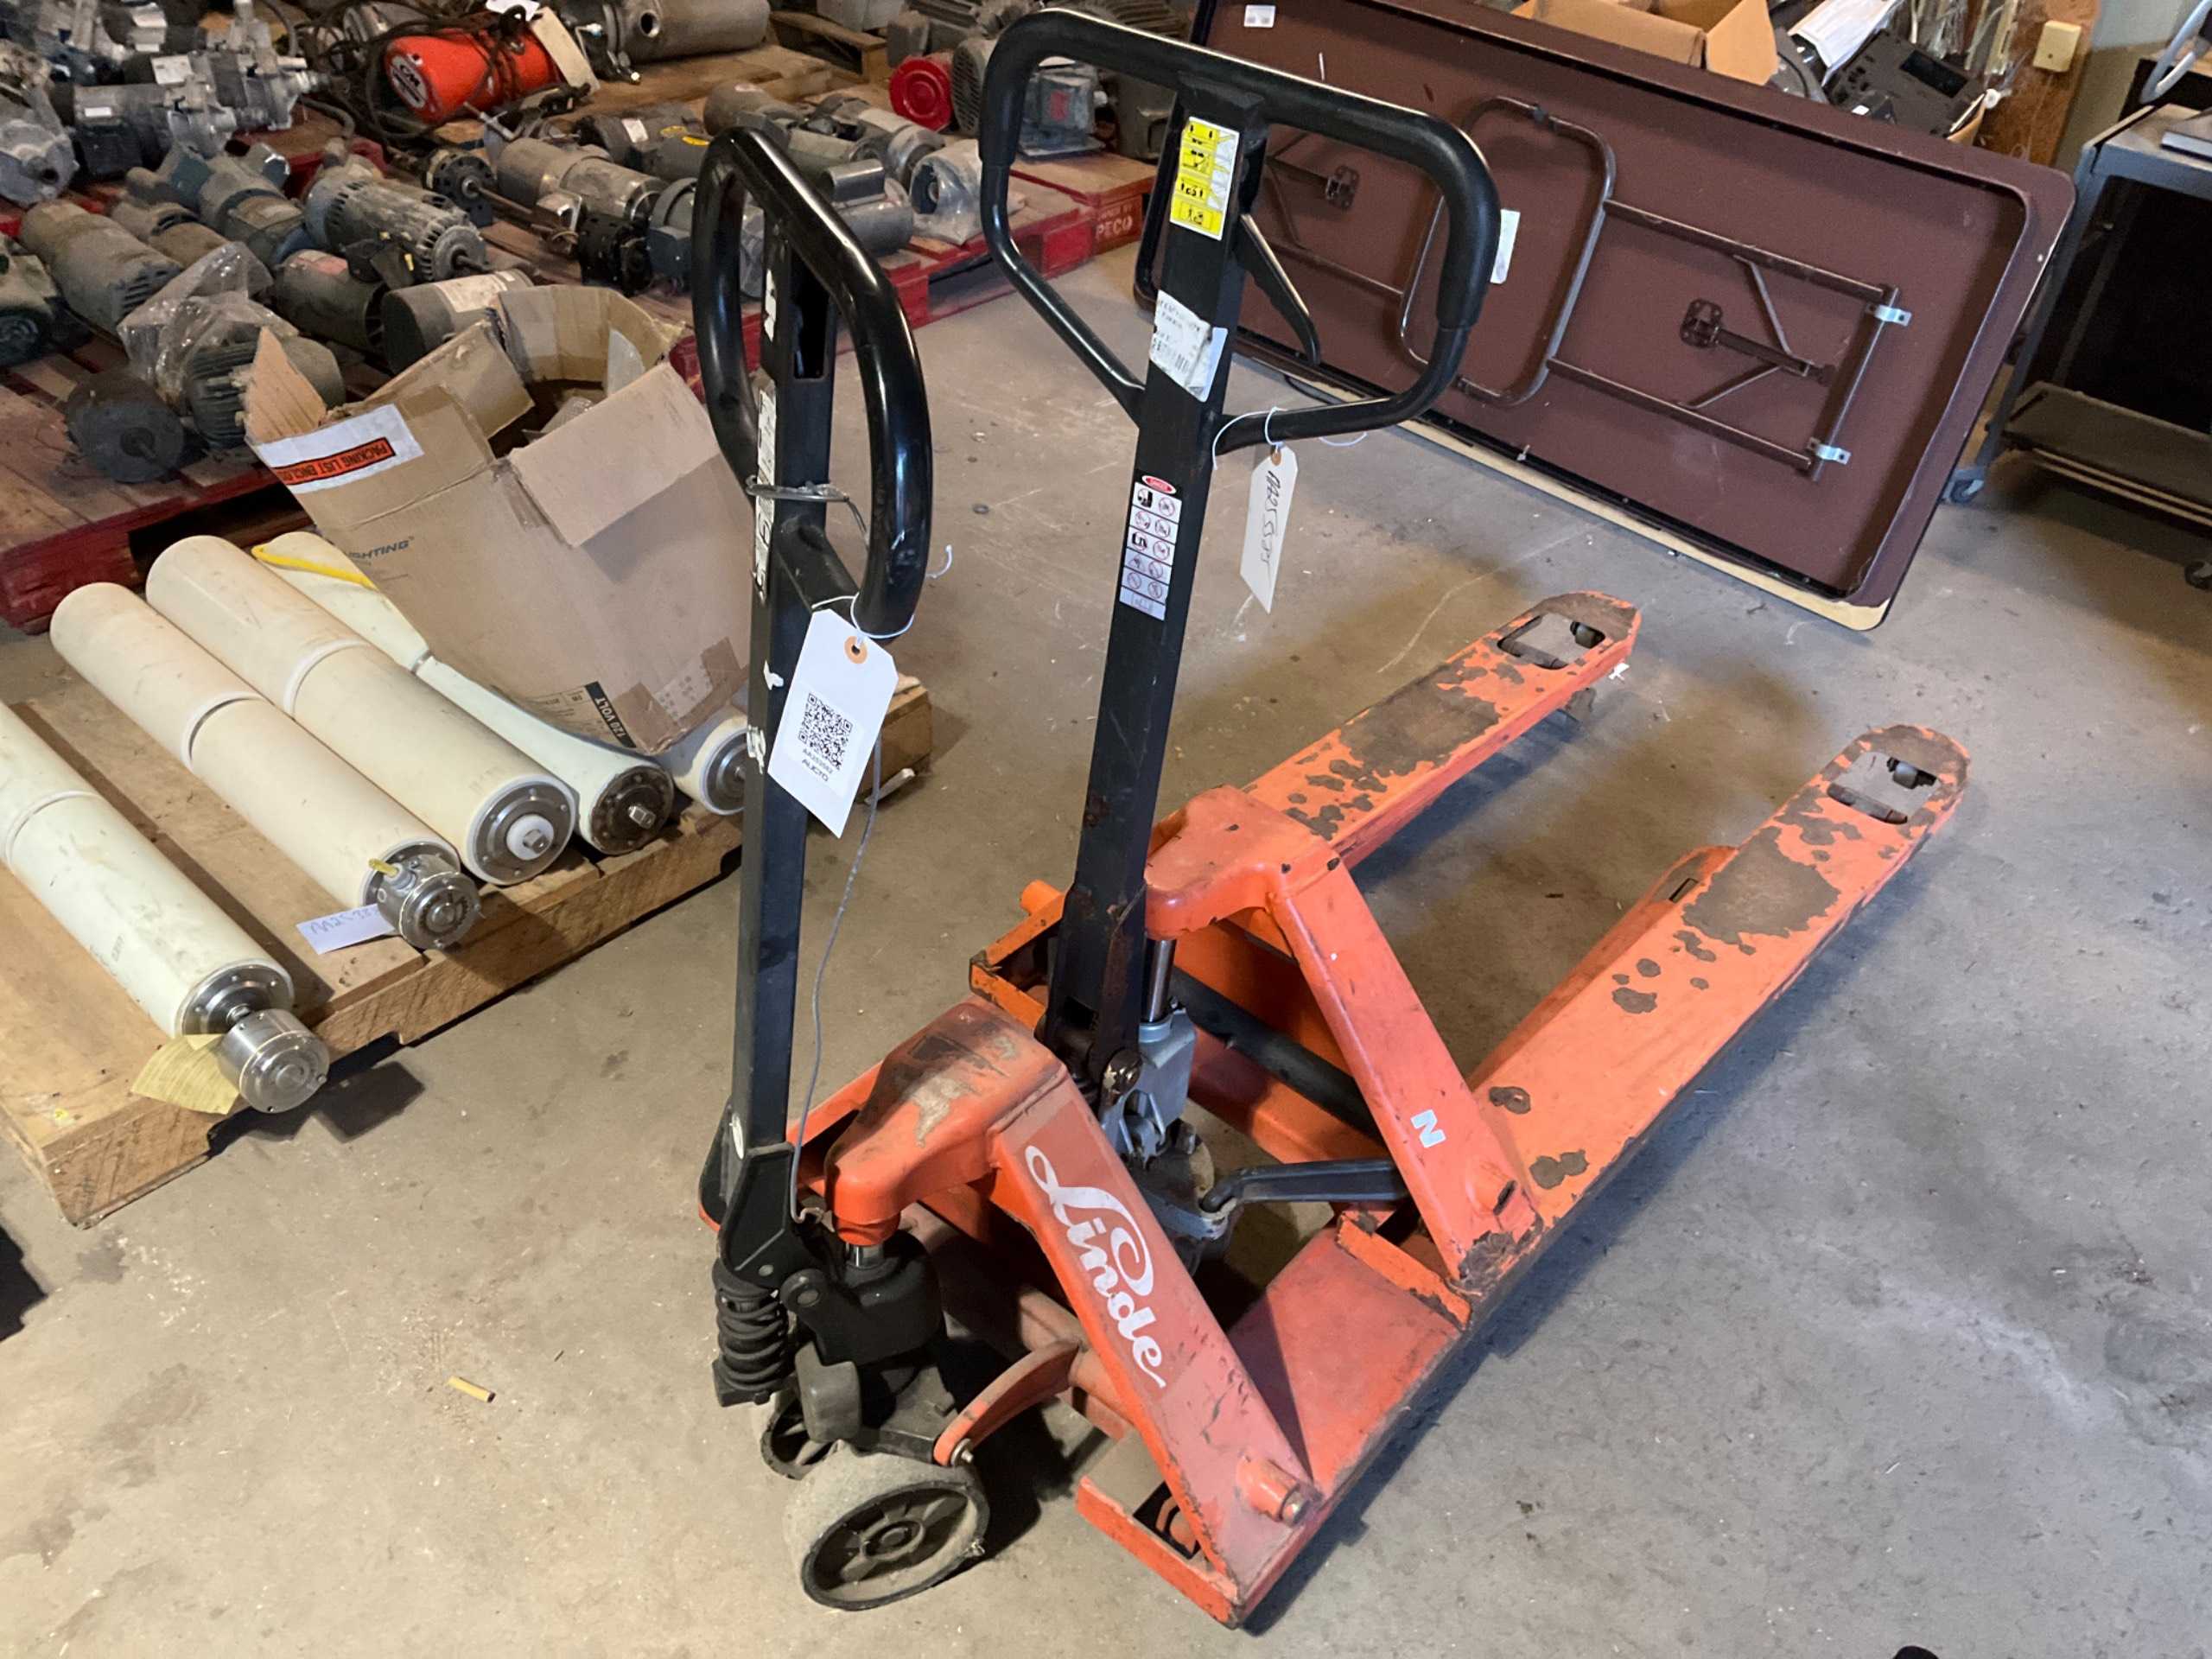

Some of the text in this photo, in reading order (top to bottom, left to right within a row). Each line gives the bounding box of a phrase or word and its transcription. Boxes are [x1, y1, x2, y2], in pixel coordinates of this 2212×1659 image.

[319, 460, 341, 474] LIST
[343, 442, 389, 466] PACKING
[594, 697, 626, 738] 120 VOLT
[1025, 1145, 1166, 1389] Linde
